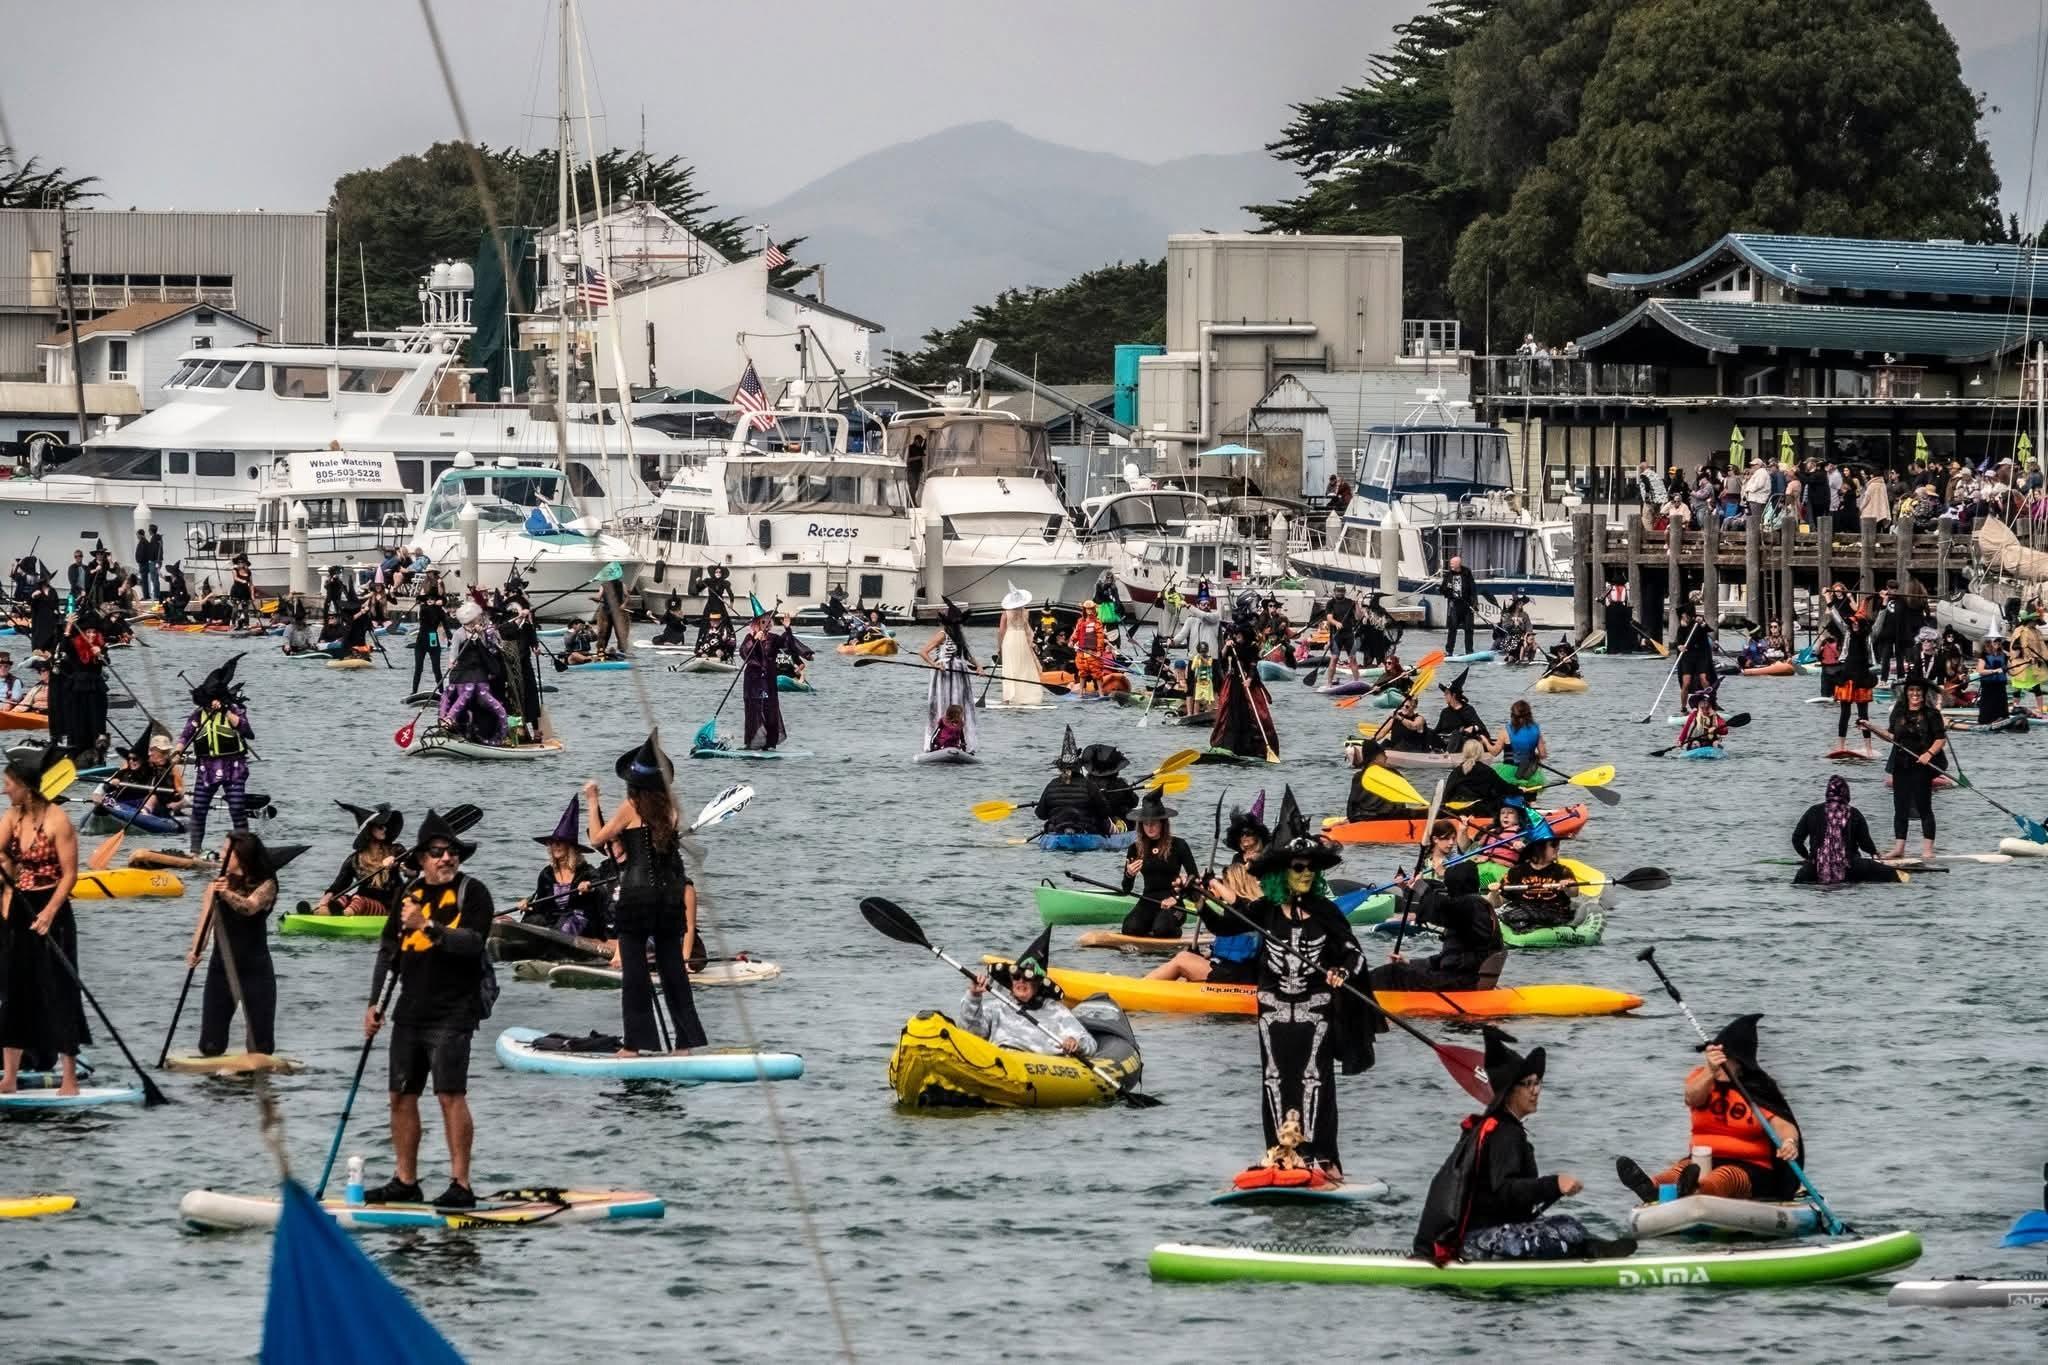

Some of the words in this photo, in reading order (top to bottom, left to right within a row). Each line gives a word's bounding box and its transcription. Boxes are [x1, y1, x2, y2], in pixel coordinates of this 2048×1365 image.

[310, 460, 339, 468] Whale
[341, 458, 383, 468] Watching
[316, 469, 380, 479] 805-503-5228
[807, 523, 859, 538] Recess
[1206, 985, 1257, 996] liquidlogi
[1024, 1063, 1080, 1080] EXPLORER
